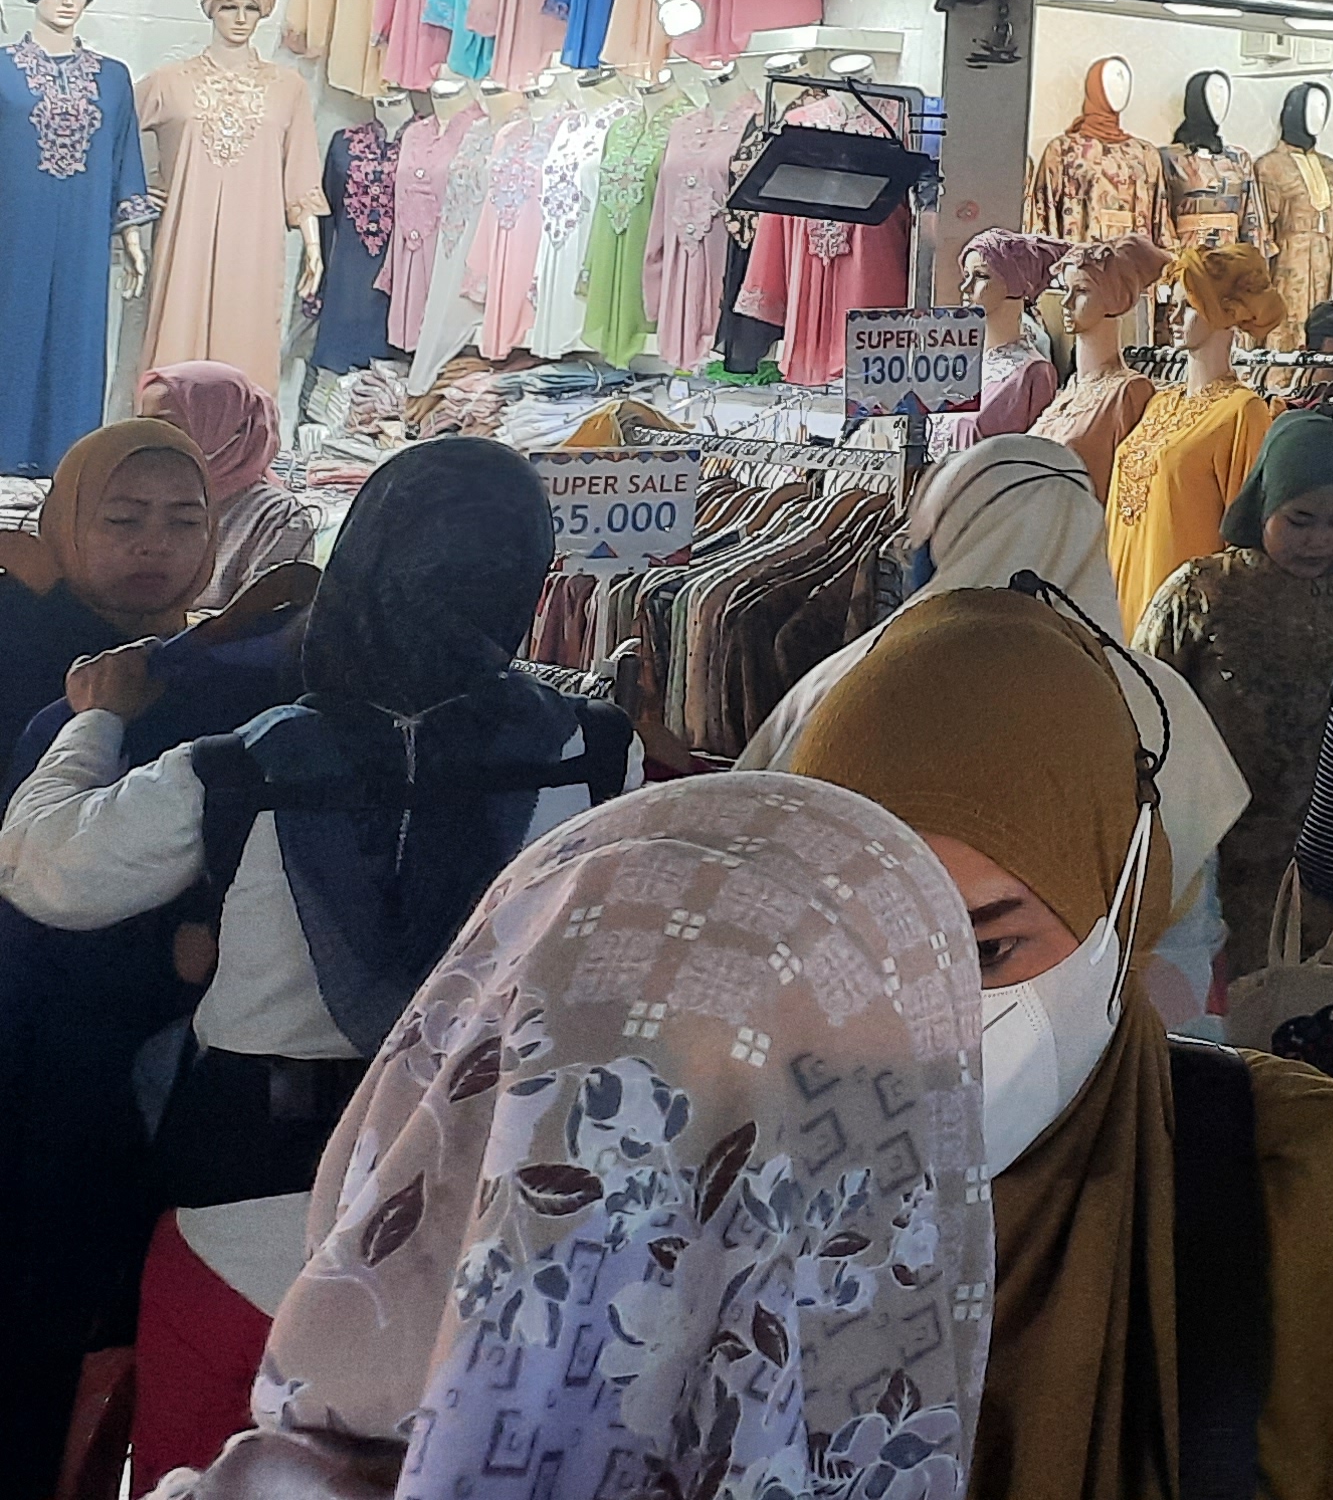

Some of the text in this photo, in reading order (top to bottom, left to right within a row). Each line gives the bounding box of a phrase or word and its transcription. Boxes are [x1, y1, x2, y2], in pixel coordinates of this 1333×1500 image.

[855, 328, 978, 350] SUPER SALE
[861, 353, 969, 385] 130.000
[540, 473, 689, 496] UPER SALE
